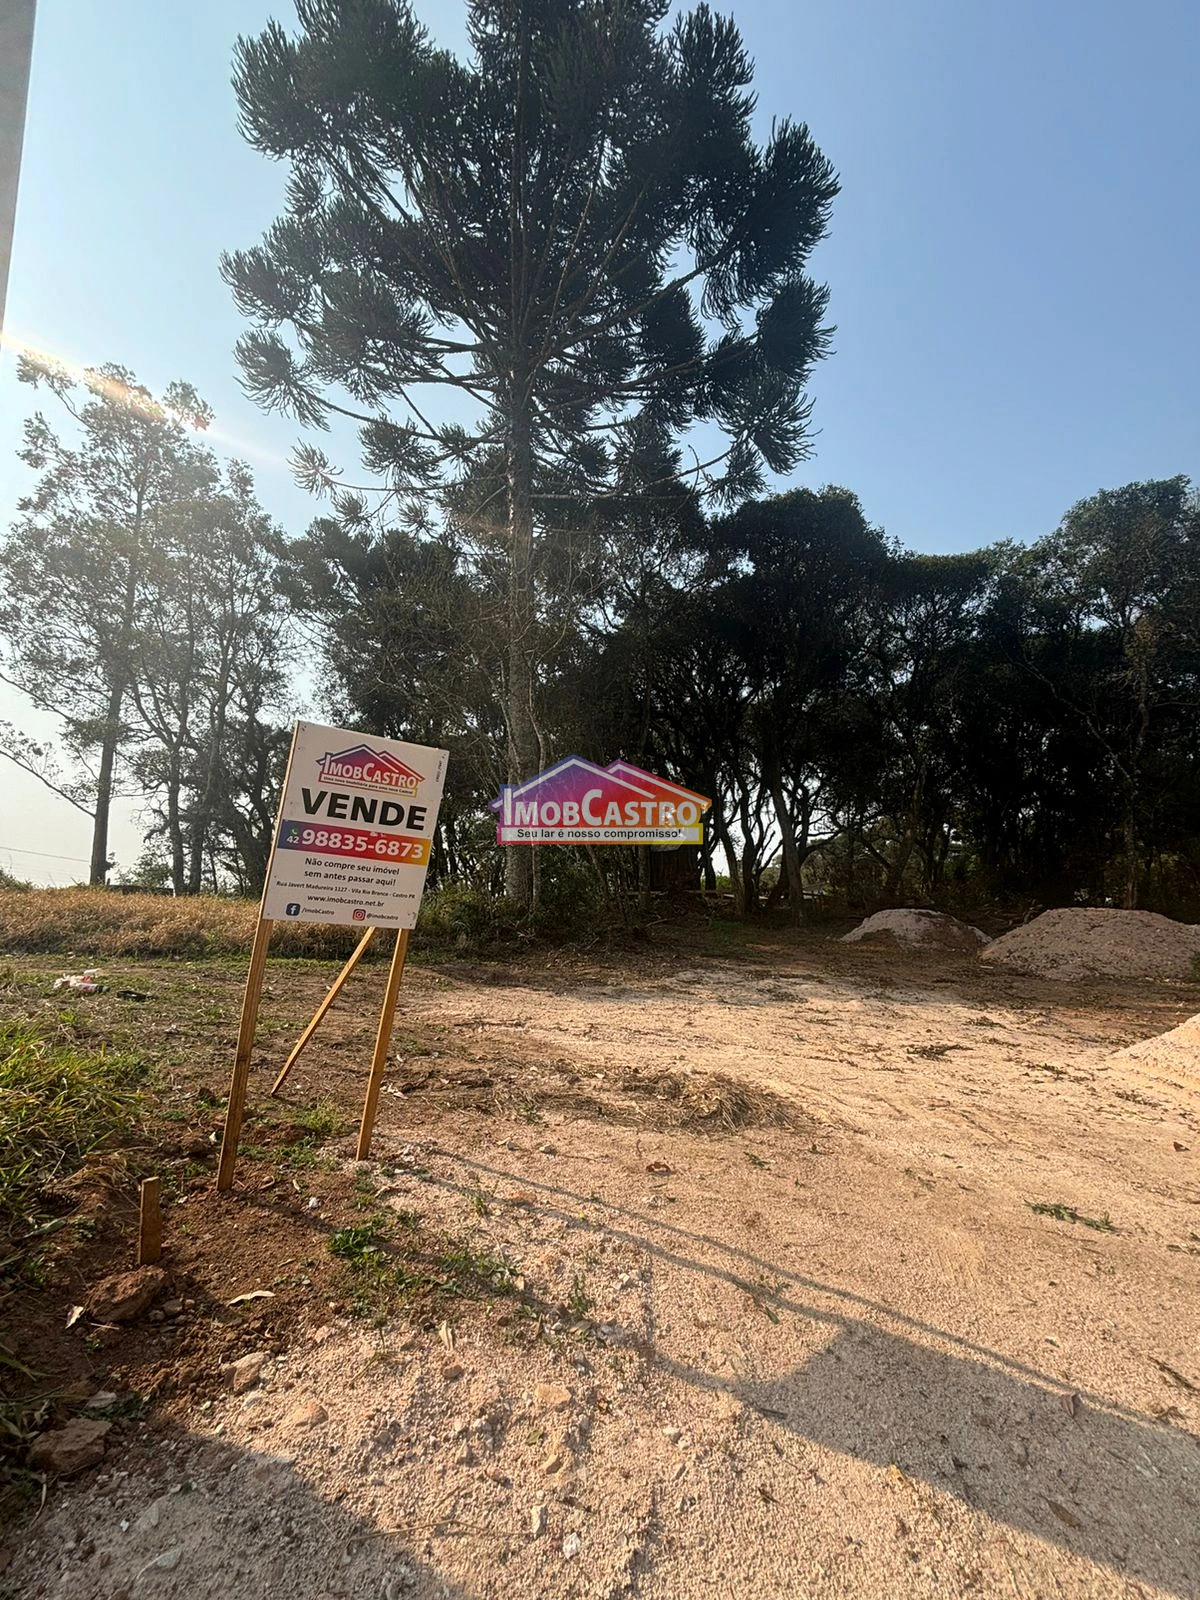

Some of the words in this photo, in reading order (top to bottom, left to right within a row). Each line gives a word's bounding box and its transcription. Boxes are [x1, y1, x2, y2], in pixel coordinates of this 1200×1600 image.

[301, 787, 427, 831] VENDE
[287, 835, 300, 844] 42
[302, 829, 424, 859] 98835-6873
[305, 858, 322, 867] Não
[324, 860, 356, 871] compre
[357, 865, 371, 873] seu
[373, 865, 400, 876] imóvel
[304, 870, 322, 879] sem
[323, 872, 346, 881] antes
[348, 875, 374, 884] passar
[376, 877, 396, 886] aqui!
[307, 895, 384, 907] www.imobcastro.net.br
